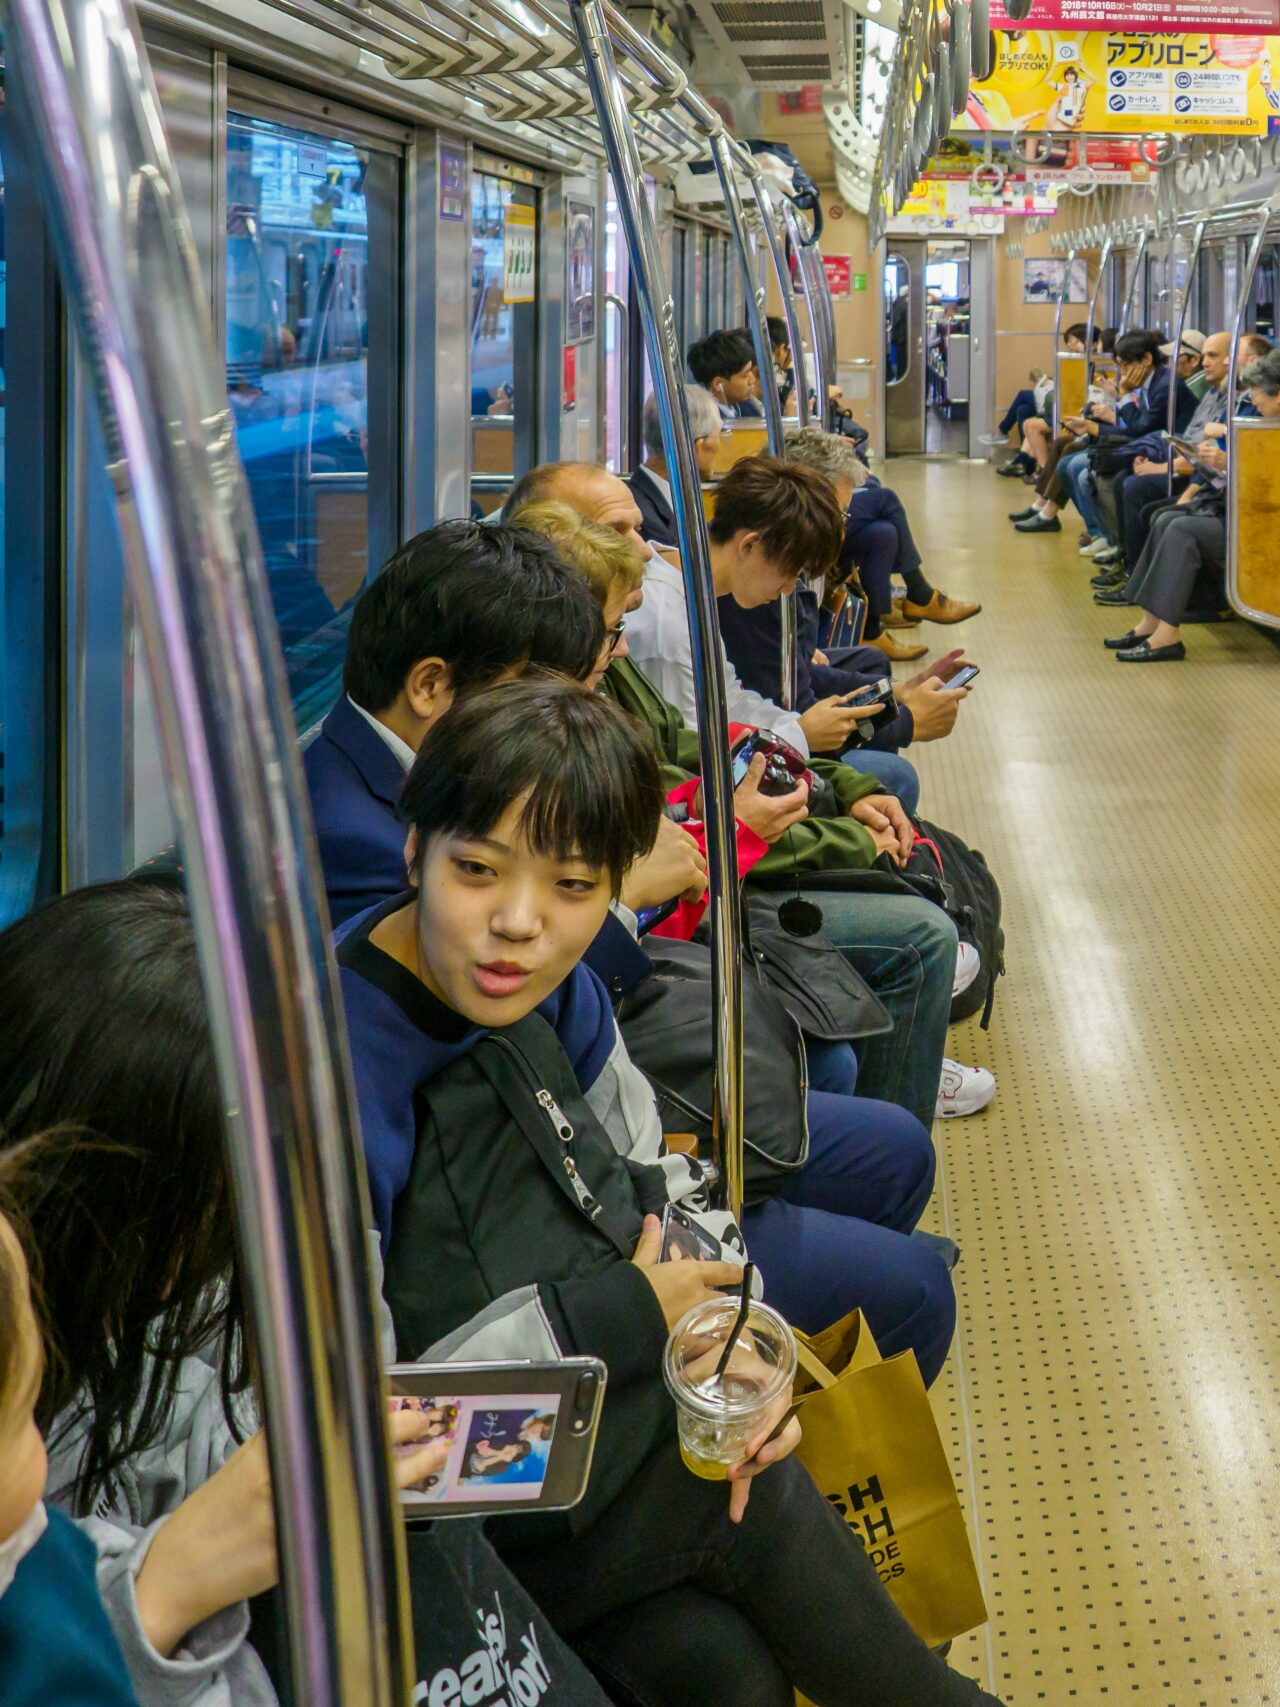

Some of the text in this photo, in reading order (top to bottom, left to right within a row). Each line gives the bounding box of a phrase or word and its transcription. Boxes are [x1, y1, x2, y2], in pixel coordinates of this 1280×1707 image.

[999, 53, 1049, 61] はじめての人も
[1107, 40, 1217, 65] アプリローン
